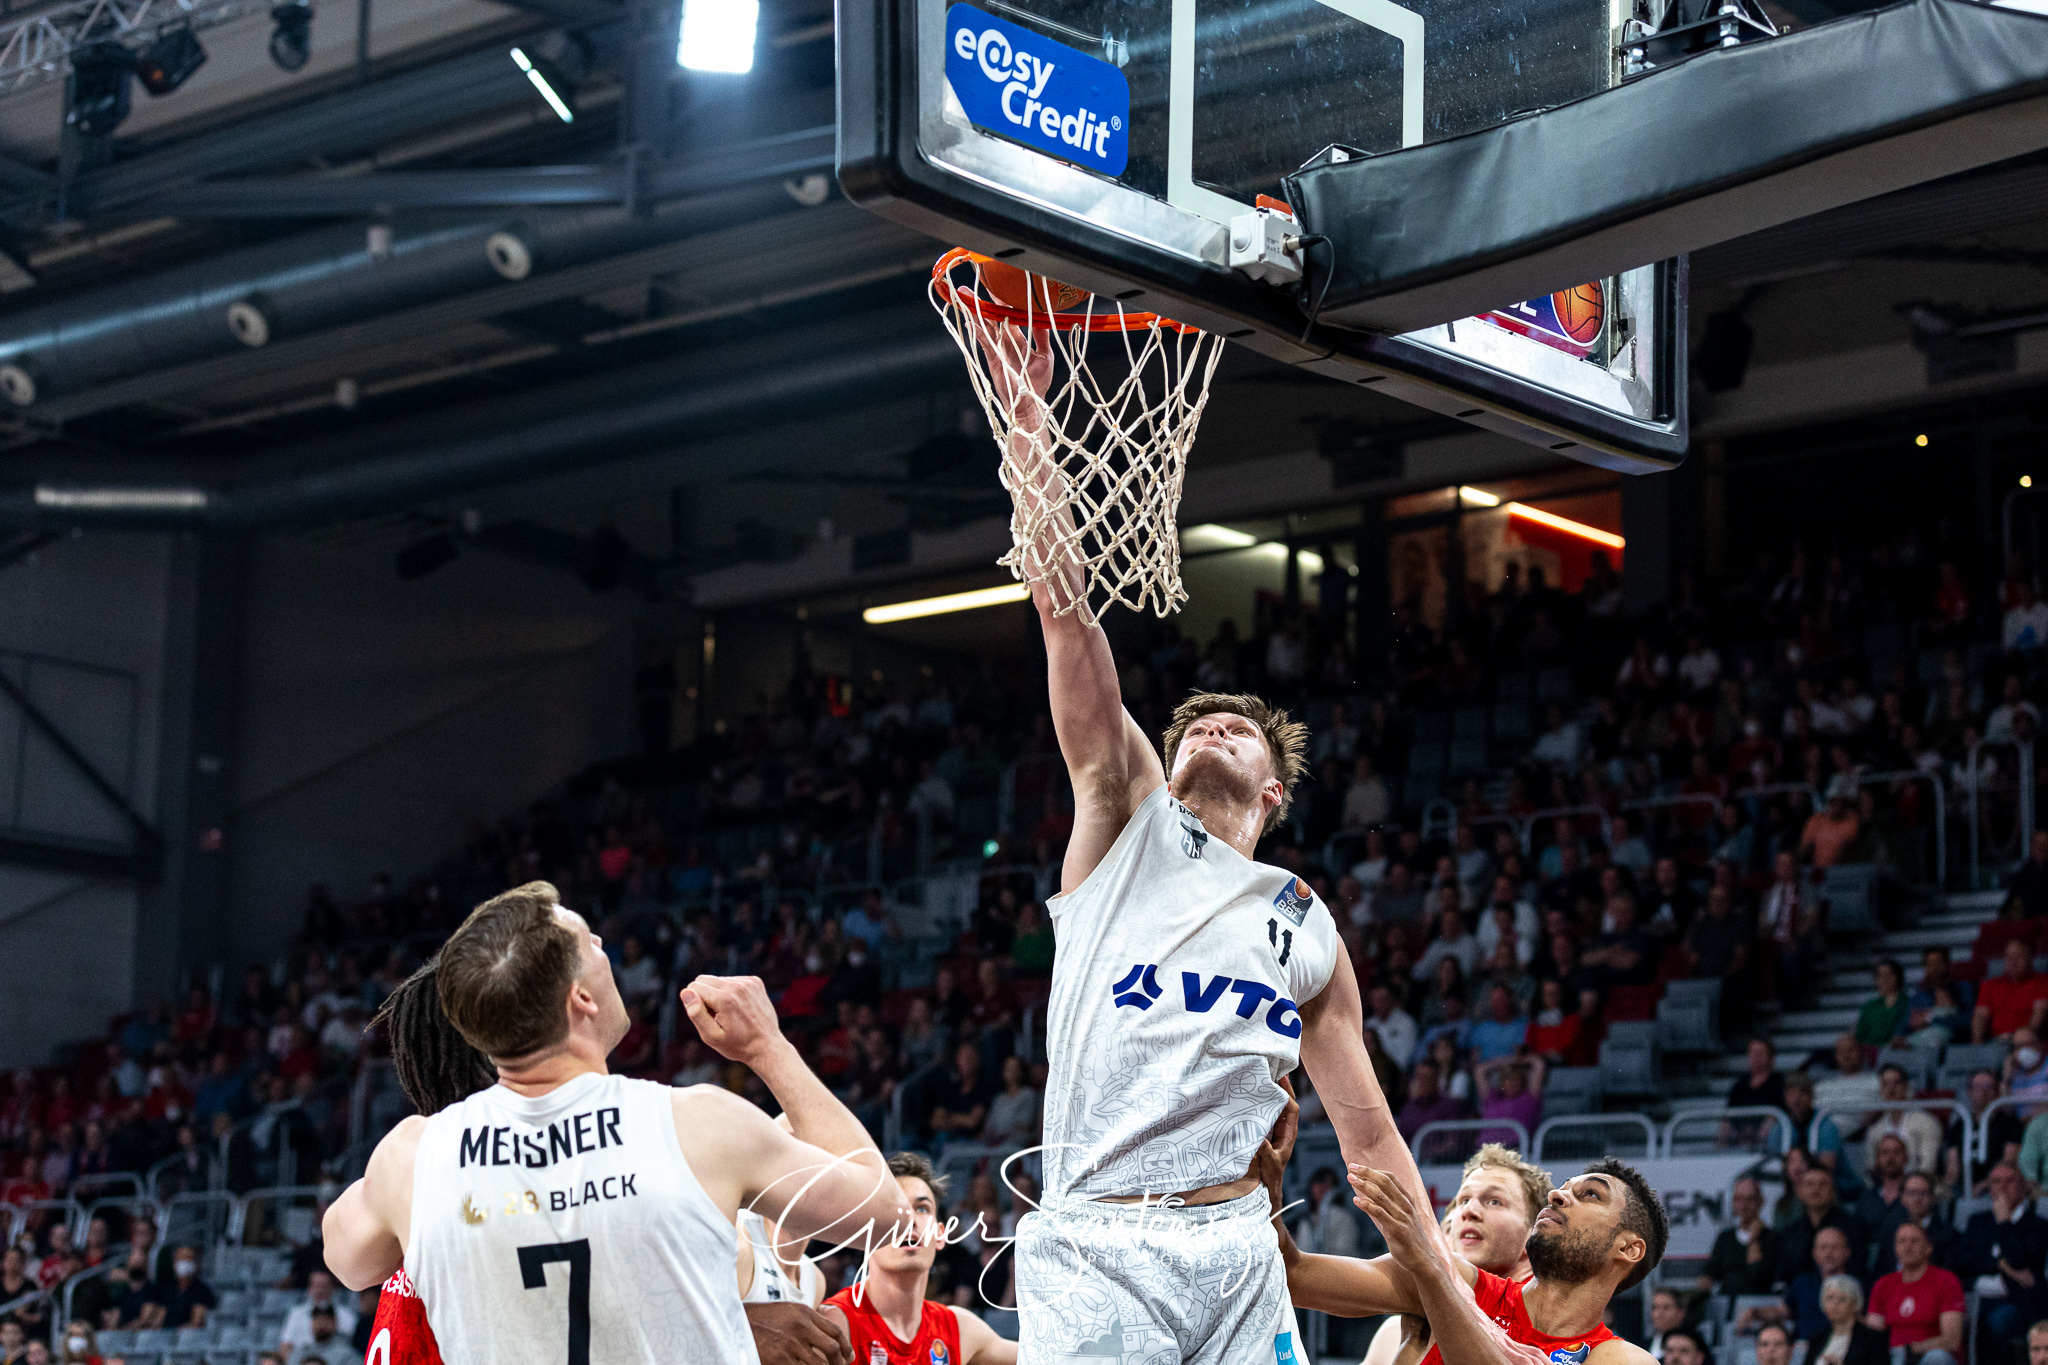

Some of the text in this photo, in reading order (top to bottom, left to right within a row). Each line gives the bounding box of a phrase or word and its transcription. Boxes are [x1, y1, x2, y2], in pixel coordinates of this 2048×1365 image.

[954, 27, 1055, 98] e@sy
[1276, 899, 1299, 923] BBL
[1267, 917, 1293, 967] 11
[460, 1107, 623, 1168] MEISNER
[504, 1173, 638, 1216] 28 BLACK
[516, 1237, 591, 1365] 7
